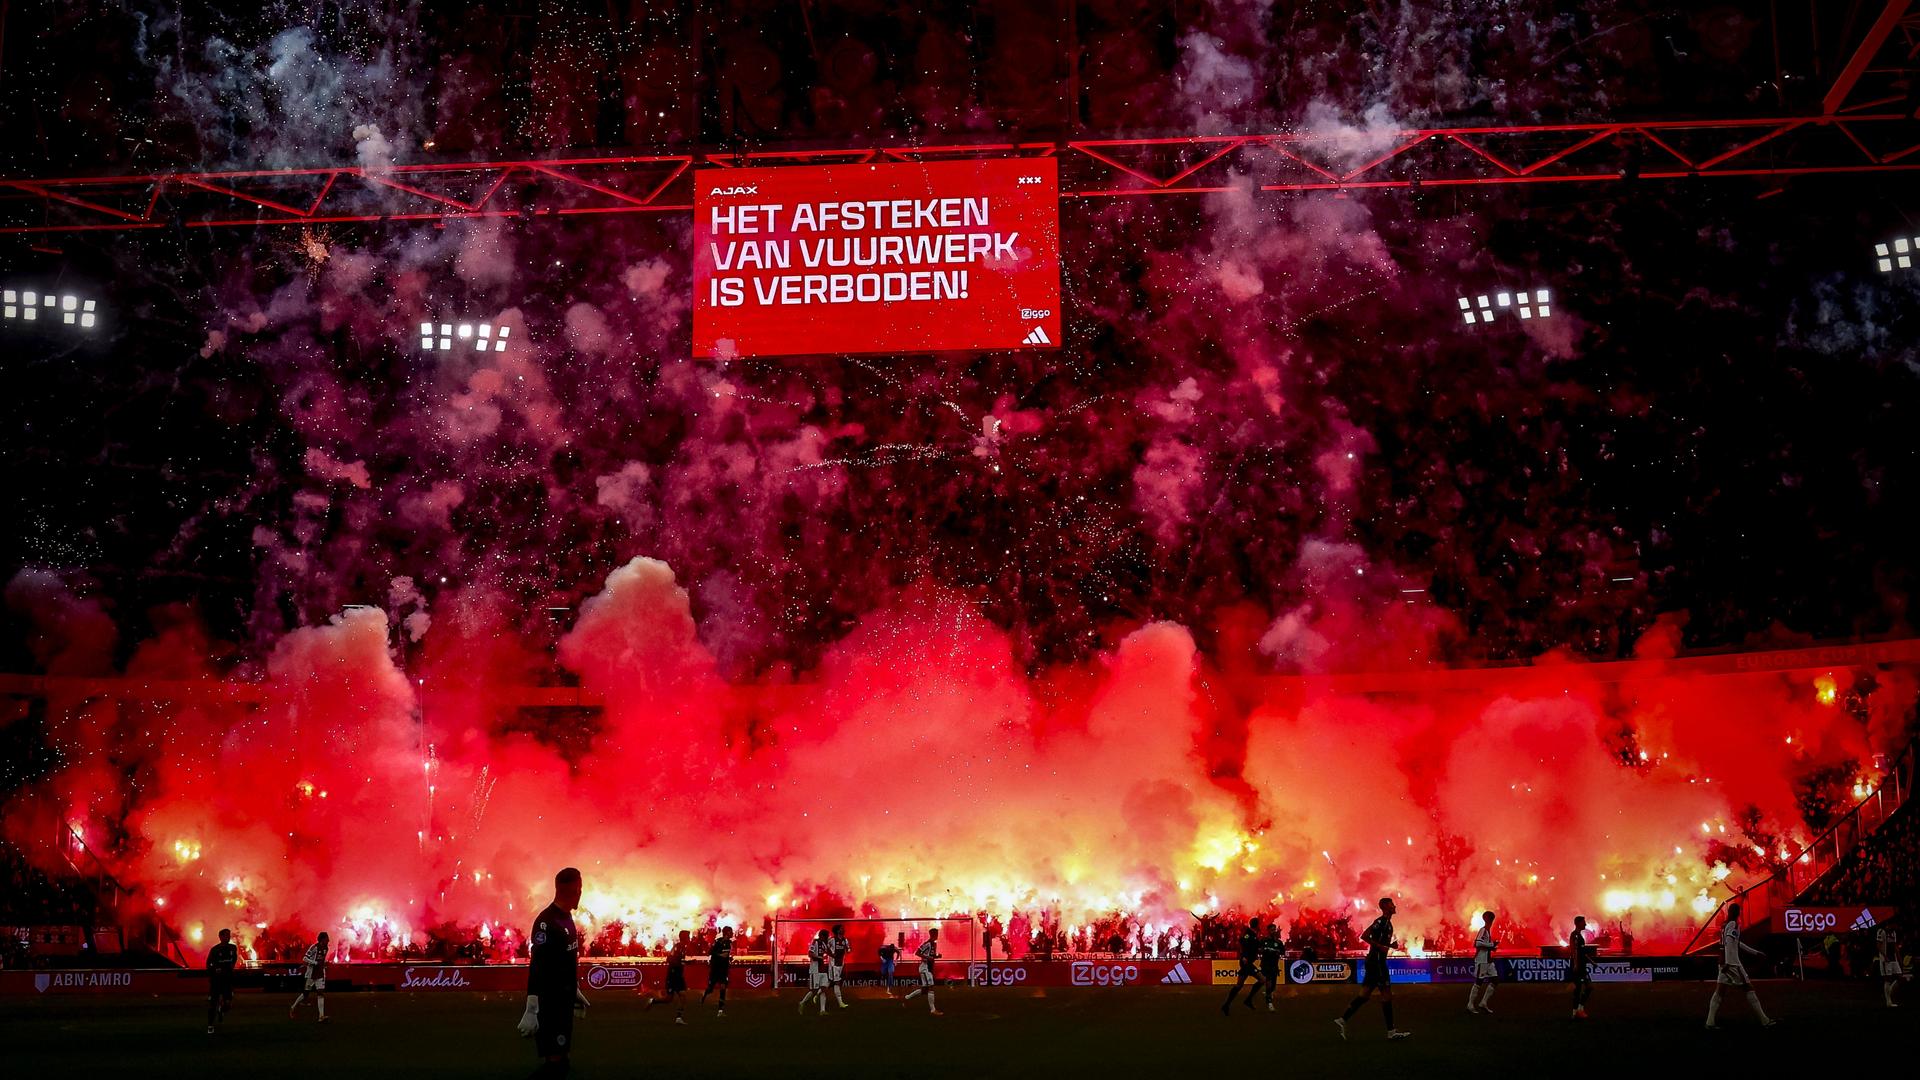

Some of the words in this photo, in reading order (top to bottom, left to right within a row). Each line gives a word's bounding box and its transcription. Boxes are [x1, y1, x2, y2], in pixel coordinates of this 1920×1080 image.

[710, 185, 758, 196] AJAX
[711, 204, 783, 235] HET
[790, 197, 989, 233] AFSTEKEN
[710, 239, 790, 271] VAN
[799, 231, 1019, 268] VUURWERK
[711, 275, 745, 307] IS
[753, 270, 969, 306] VERBODEN!
[1508, 959, 1571, 969] VRIENDEN
[1517, 969, 1565, 981] LOTERIJ
